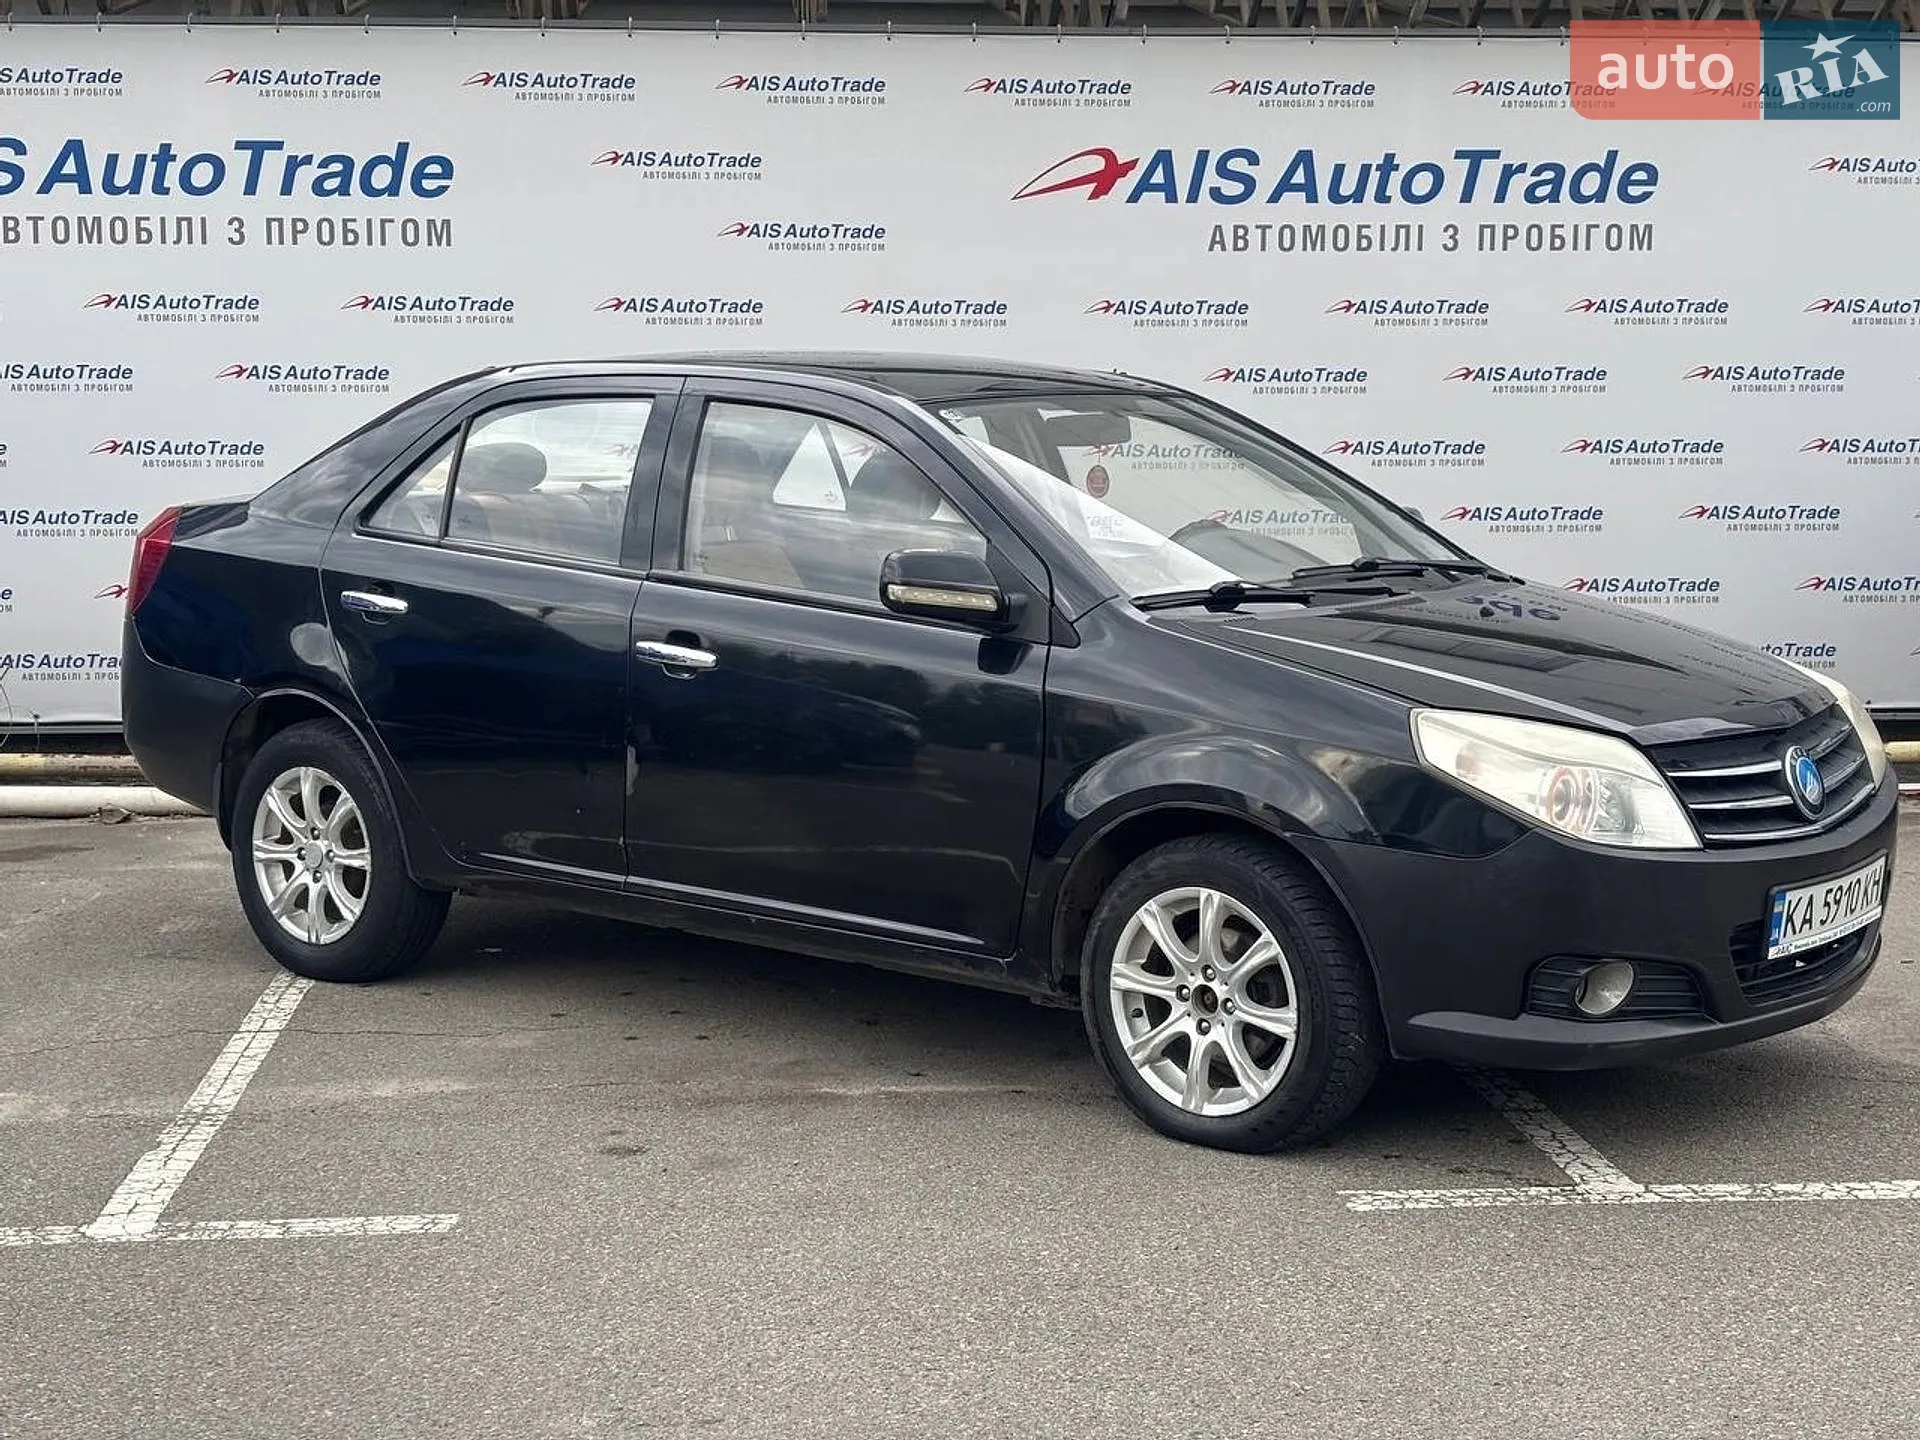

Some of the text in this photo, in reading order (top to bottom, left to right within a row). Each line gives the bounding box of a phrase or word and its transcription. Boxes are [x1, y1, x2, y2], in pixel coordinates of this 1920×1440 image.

[14, 67, 124, 84] AutoTrade
[235, 68, 382, 87] AIS AutoTrade
[492, 71, 636, 91] AIS AutoTrade
[744, 75, 887, 94] AIS AutoTrade
[994, 78, 1133, 96] AIS AutoTrade
[1237, 79, 1376, 96] AIS AutoTrade
[1480, 80, 1516, 96] AIS
[35, 137, 455, 199] AutoTrade
[620, 151, 762, 169] AIS AutoTrade
[1836, 157, 1920, 173] AIS Auto
[1126, 147, 1659, 206] AIS AutoTrade
[0, 214, 452, 248] ВТОМОБІЛІ З ПРОБІГОМ
[746, 222, 886, 240] AIS AutoTrade
[1207, 222, 1653, 253] АВТОМОБІЛІ З ПРОБІГОМ
[113, 293, 260, 313] AIS AutoTrade
[369, 295, 515, 312] AIS AutoTrade
[622, 297, 764, 315] AIS AutoTrade
[869, 299, 1008, 315] AIS AutoTrade
[1111, 299, 1250, 317] AIS AutoTrade
[1351, 298, 1490, 315] AIS AutoTrade
[1592, 298, 1730, 314] AIS AutoTrade
[1831, 298, 1867, 314] AIS
[0, 364, 134, 380] IS AutoTrade
[245, 364, 390, 381] AIS AutoTrade
[1231, 367, 1369, 385] AIS AutoTrade
[1471, 365, 1608, 383] AIS AutoTrade
[1708, 365, 1846, 381] AIS AutoTrade
[118, 439, 265, 456] AIS AutoTrade
[1350, 439, 1486, 456] AIS AutoTrade
[1589, 438, 1725, 455] AIS AutoTrade
[1827, 438, 1862, 454] AIS
[31, 509, 138, 525] AutoTrade
[1230, 509, 1264, 524] AIS
[1468, 505, 1604, 522] AIS AutoTrade
[1705, 504, 1841, 521] AIS AutoTrade
[1586, 577, 1721, 593] AIS AutoTrade
[1823, 576, 1857, 592] AIS
[0, 653, 36, 669] AIS
[1783, 894, 1815, 938] KA
[1819, 876, 1861, 927] 5910
[1861, 864, 1882, 910] KH
